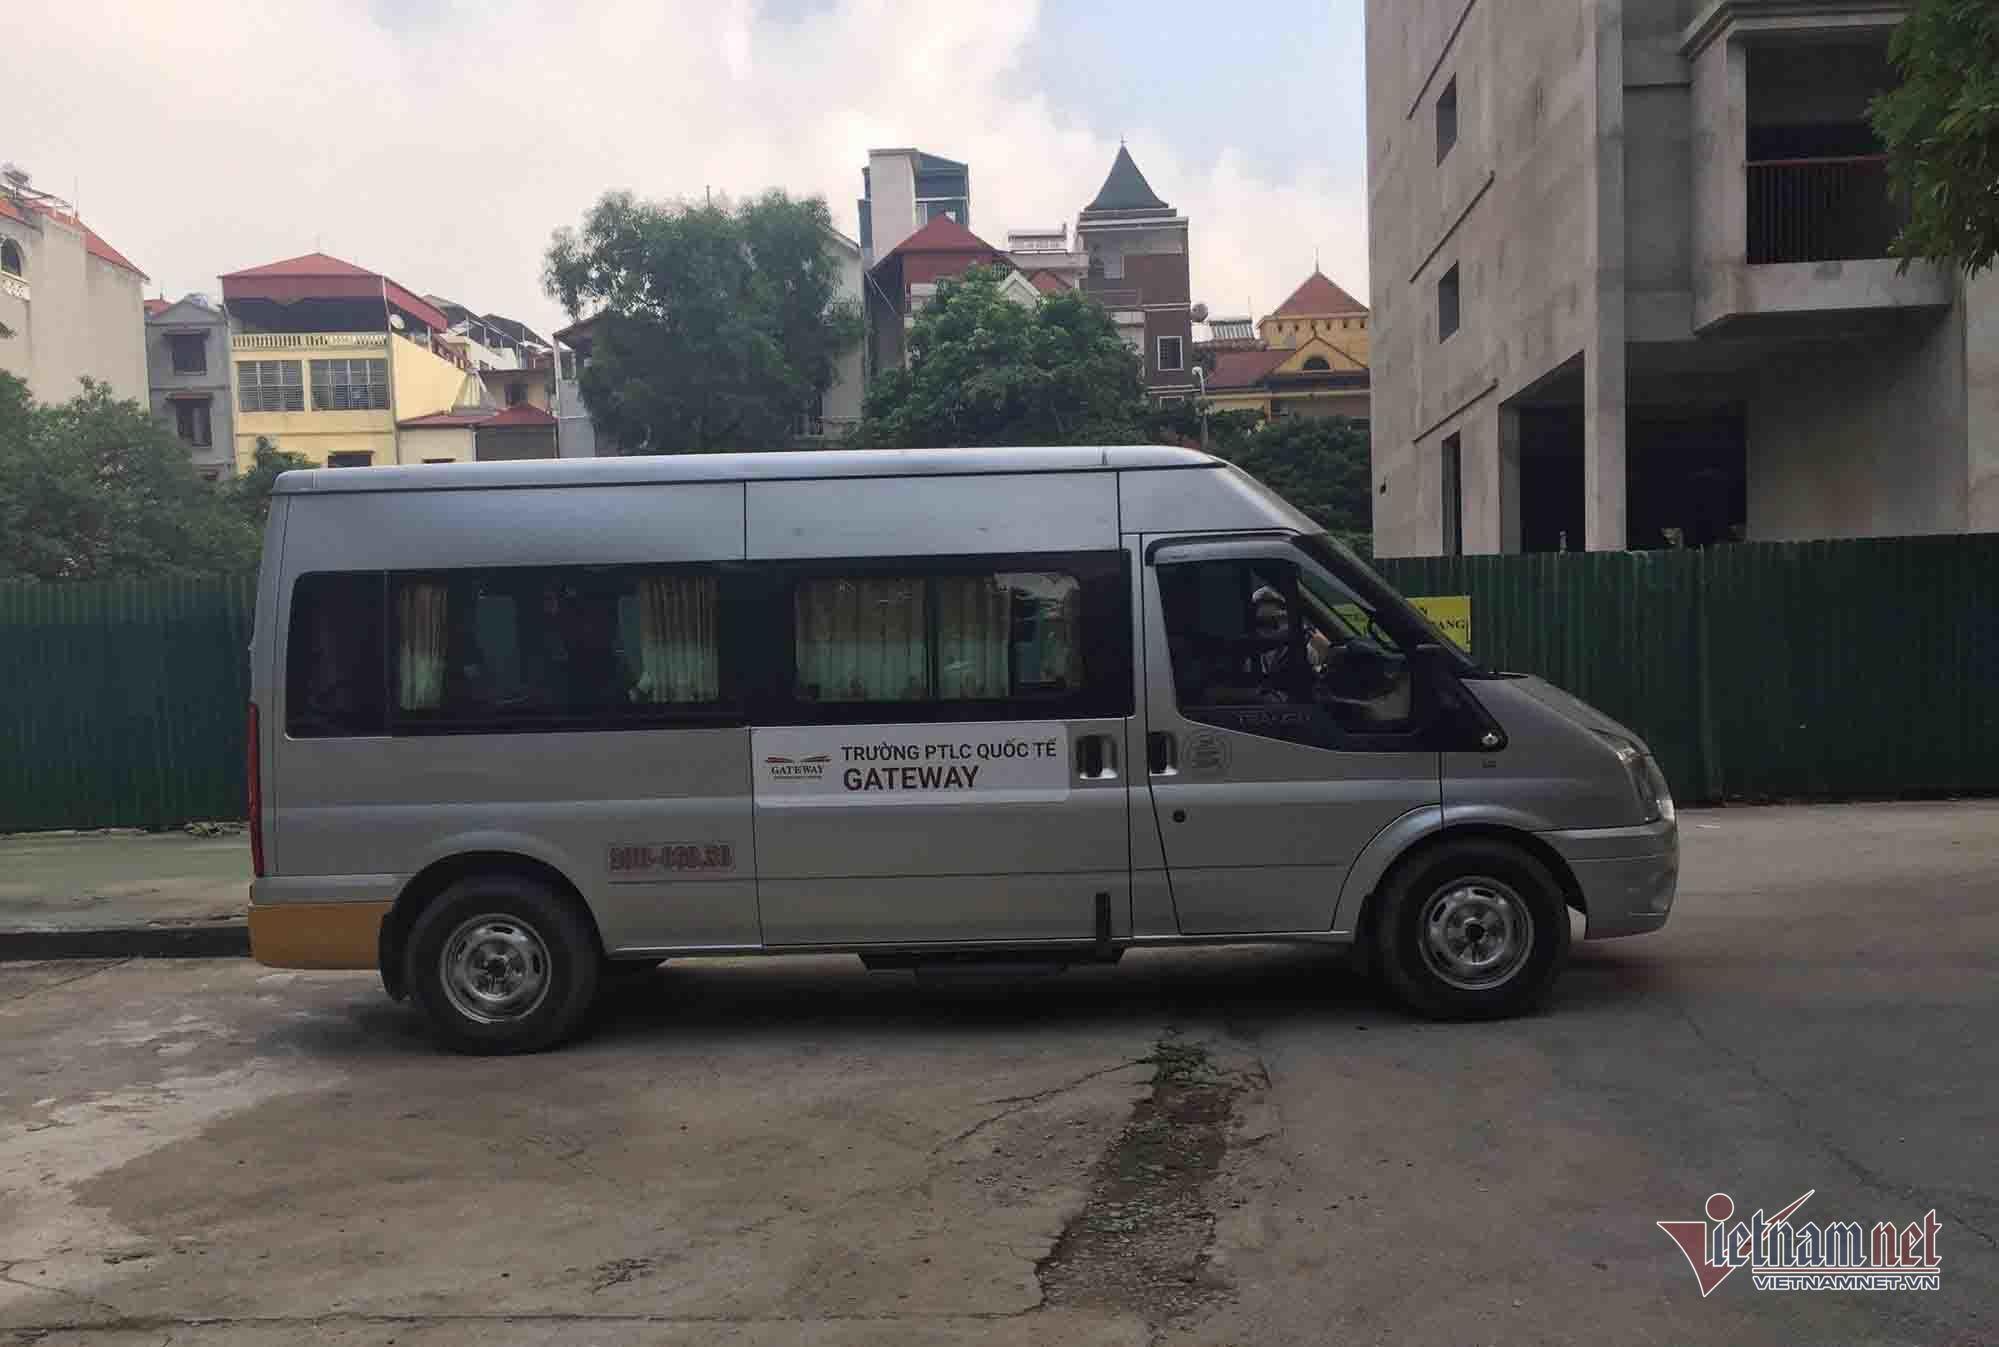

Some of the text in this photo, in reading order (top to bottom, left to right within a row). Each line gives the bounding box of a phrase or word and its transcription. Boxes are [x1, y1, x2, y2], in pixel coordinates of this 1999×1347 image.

[840, 736, 1057, 761] TRƯỜNG PTLC QUỐC TẾ
[771, 765, 824, 775] GATEWAY
[843, 765, 979, 791] GATEWAY
